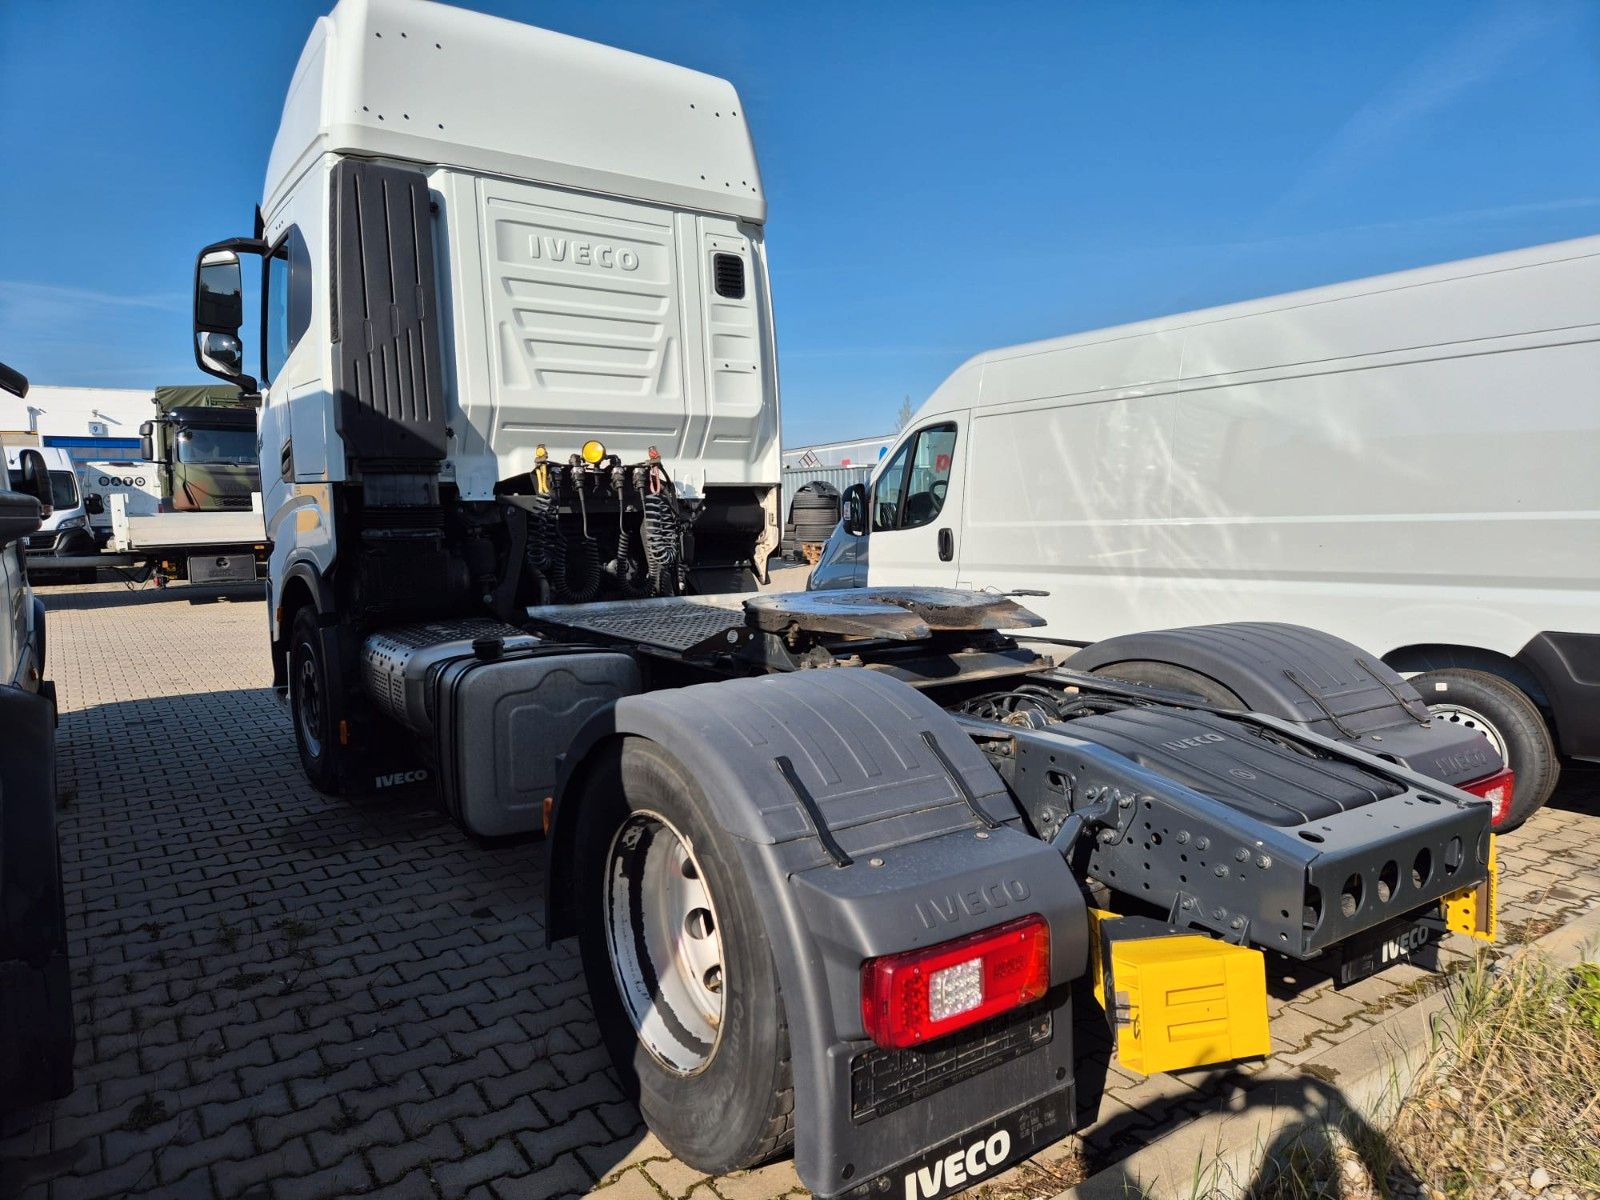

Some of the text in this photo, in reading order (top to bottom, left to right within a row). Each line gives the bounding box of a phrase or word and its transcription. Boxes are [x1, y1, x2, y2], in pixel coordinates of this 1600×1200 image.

[528, 234, 640, 271] IVECO
[1161, 733, 1226, 751] IVECO
[375, 769, 428, 788] IVECO
[915, 879, 1031, 929] IVECO
[1382, 926, 1429, 963] IVECO
[905, 1129, 1011, 1200] IVECO
